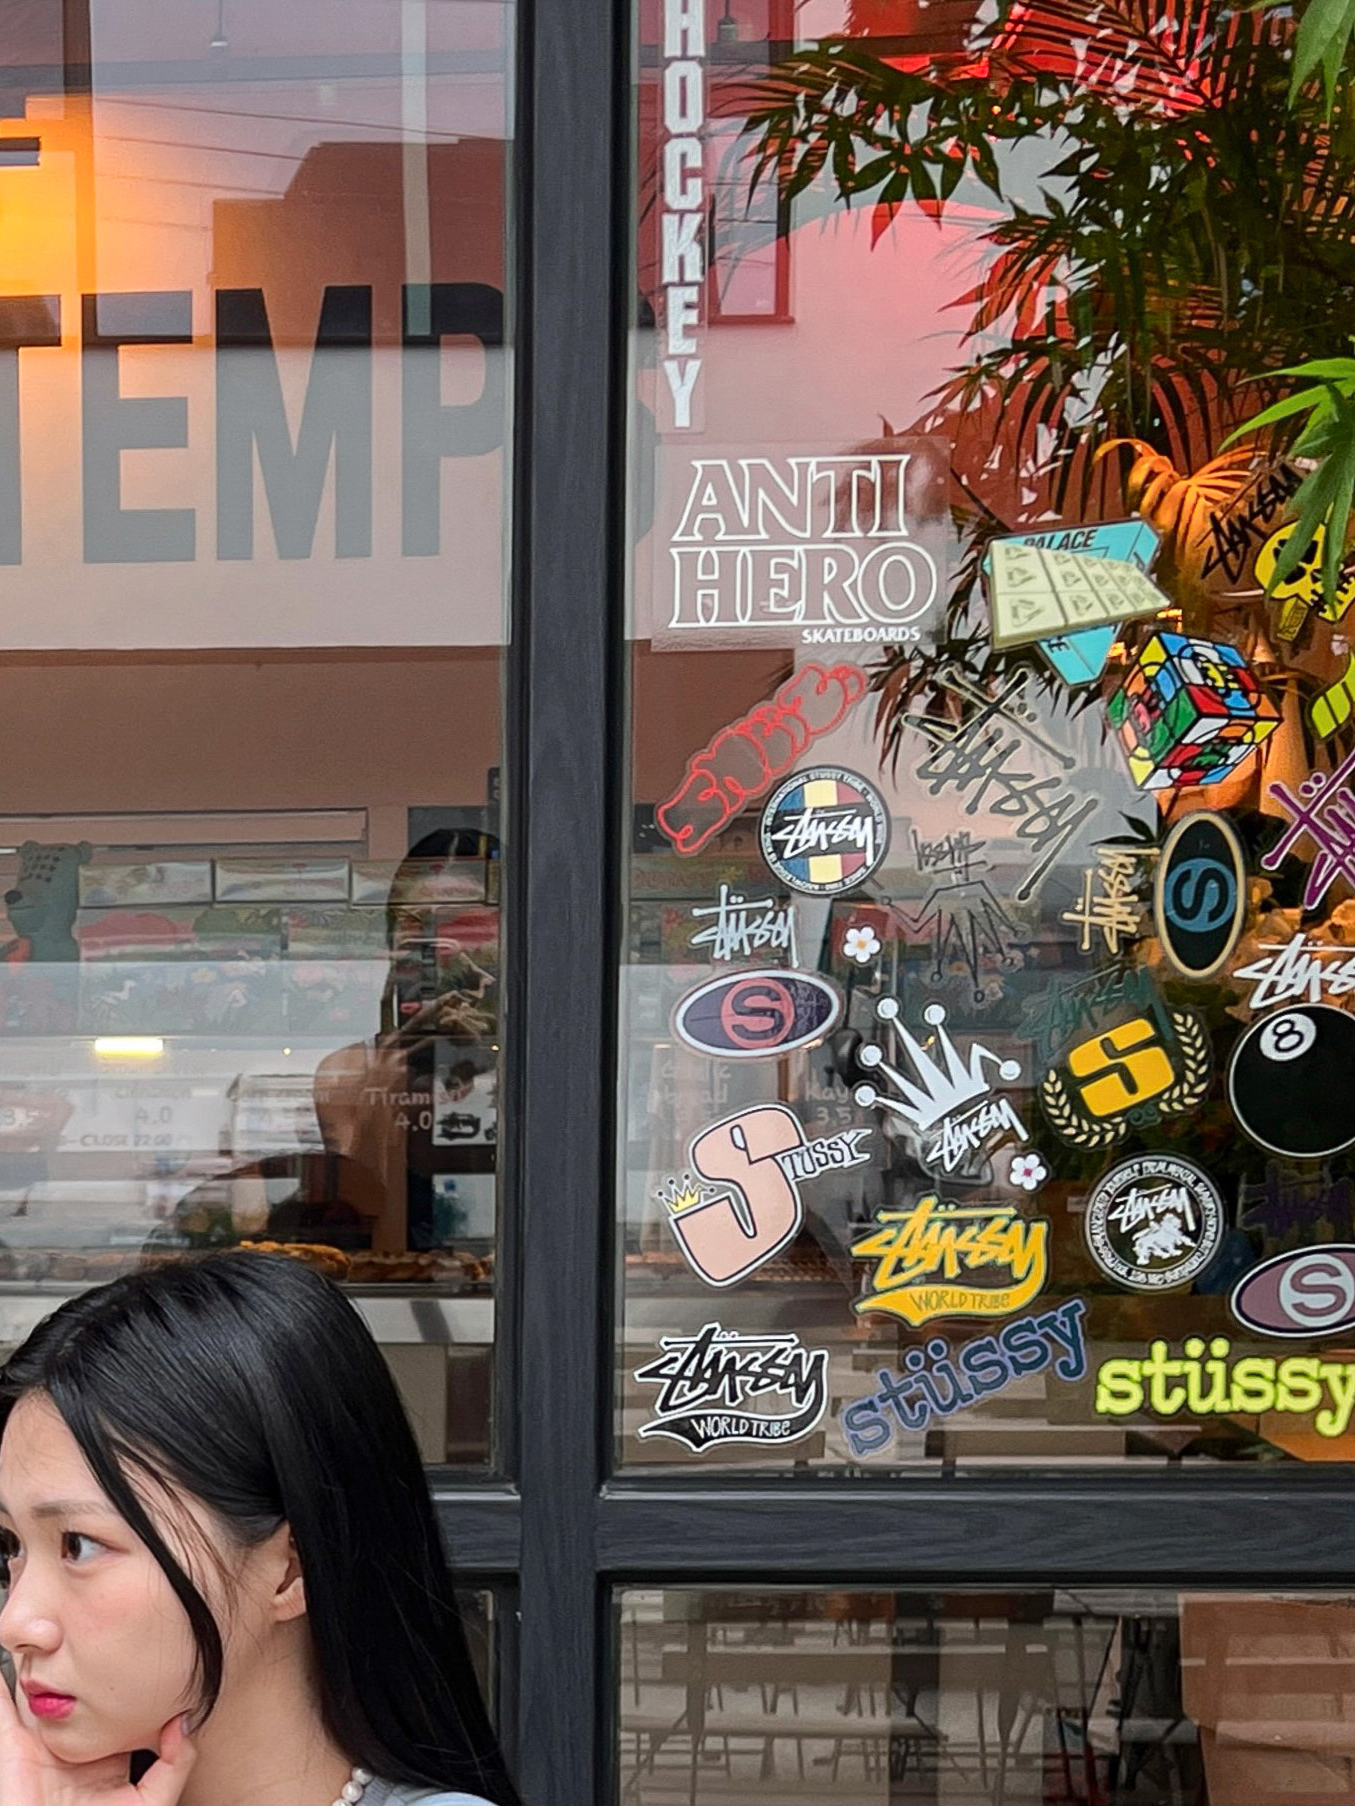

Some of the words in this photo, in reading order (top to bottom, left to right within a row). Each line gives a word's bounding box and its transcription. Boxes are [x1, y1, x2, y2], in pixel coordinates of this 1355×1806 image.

[662, 0, 705, 429] HOCKEY
[670, 454, 911, 541] ANTI
[668, 542, 937, 628] HERO
[802, 626, 921, 643] SKATEBOARDS
[1272, 1018, 1306, 1053] 8
[1068, 1018, 1175, 1117] S
[396, 1111, 433, 1132] 4.0
[911, 1291, 967, 1311] WORLD
[1290, 1262, 1347, 1318] S
[691, 1416, 749, 1438] WORLD
